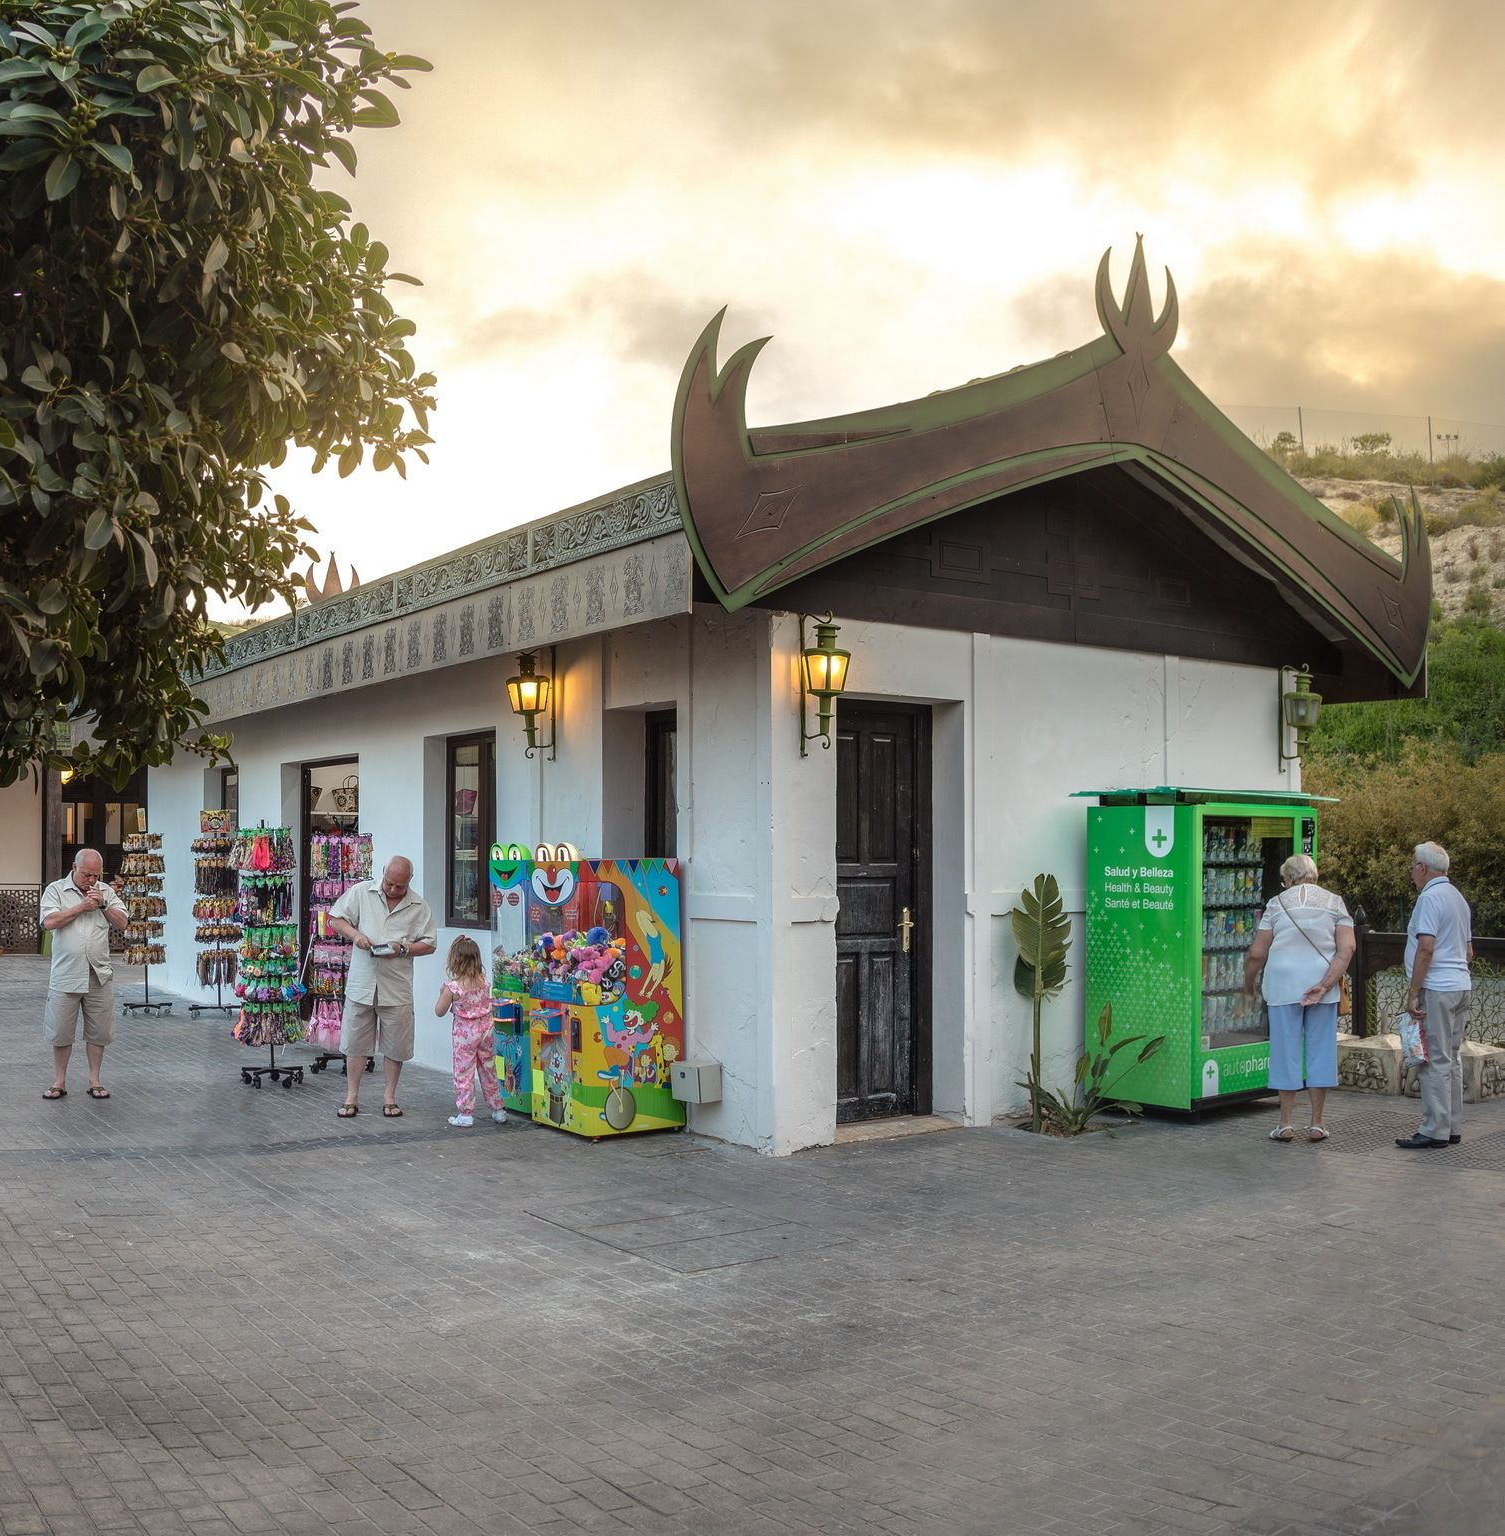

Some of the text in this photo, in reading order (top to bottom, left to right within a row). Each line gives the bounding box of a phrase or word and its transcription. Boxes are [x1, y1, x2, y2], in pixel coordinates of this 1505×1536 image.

[1104, 866, 1174, 879] Salud y Belleza
[1104, 882, 1174, 897] Health & Beauty
[1105, 897, 1174, 910] Santé et Beauté
